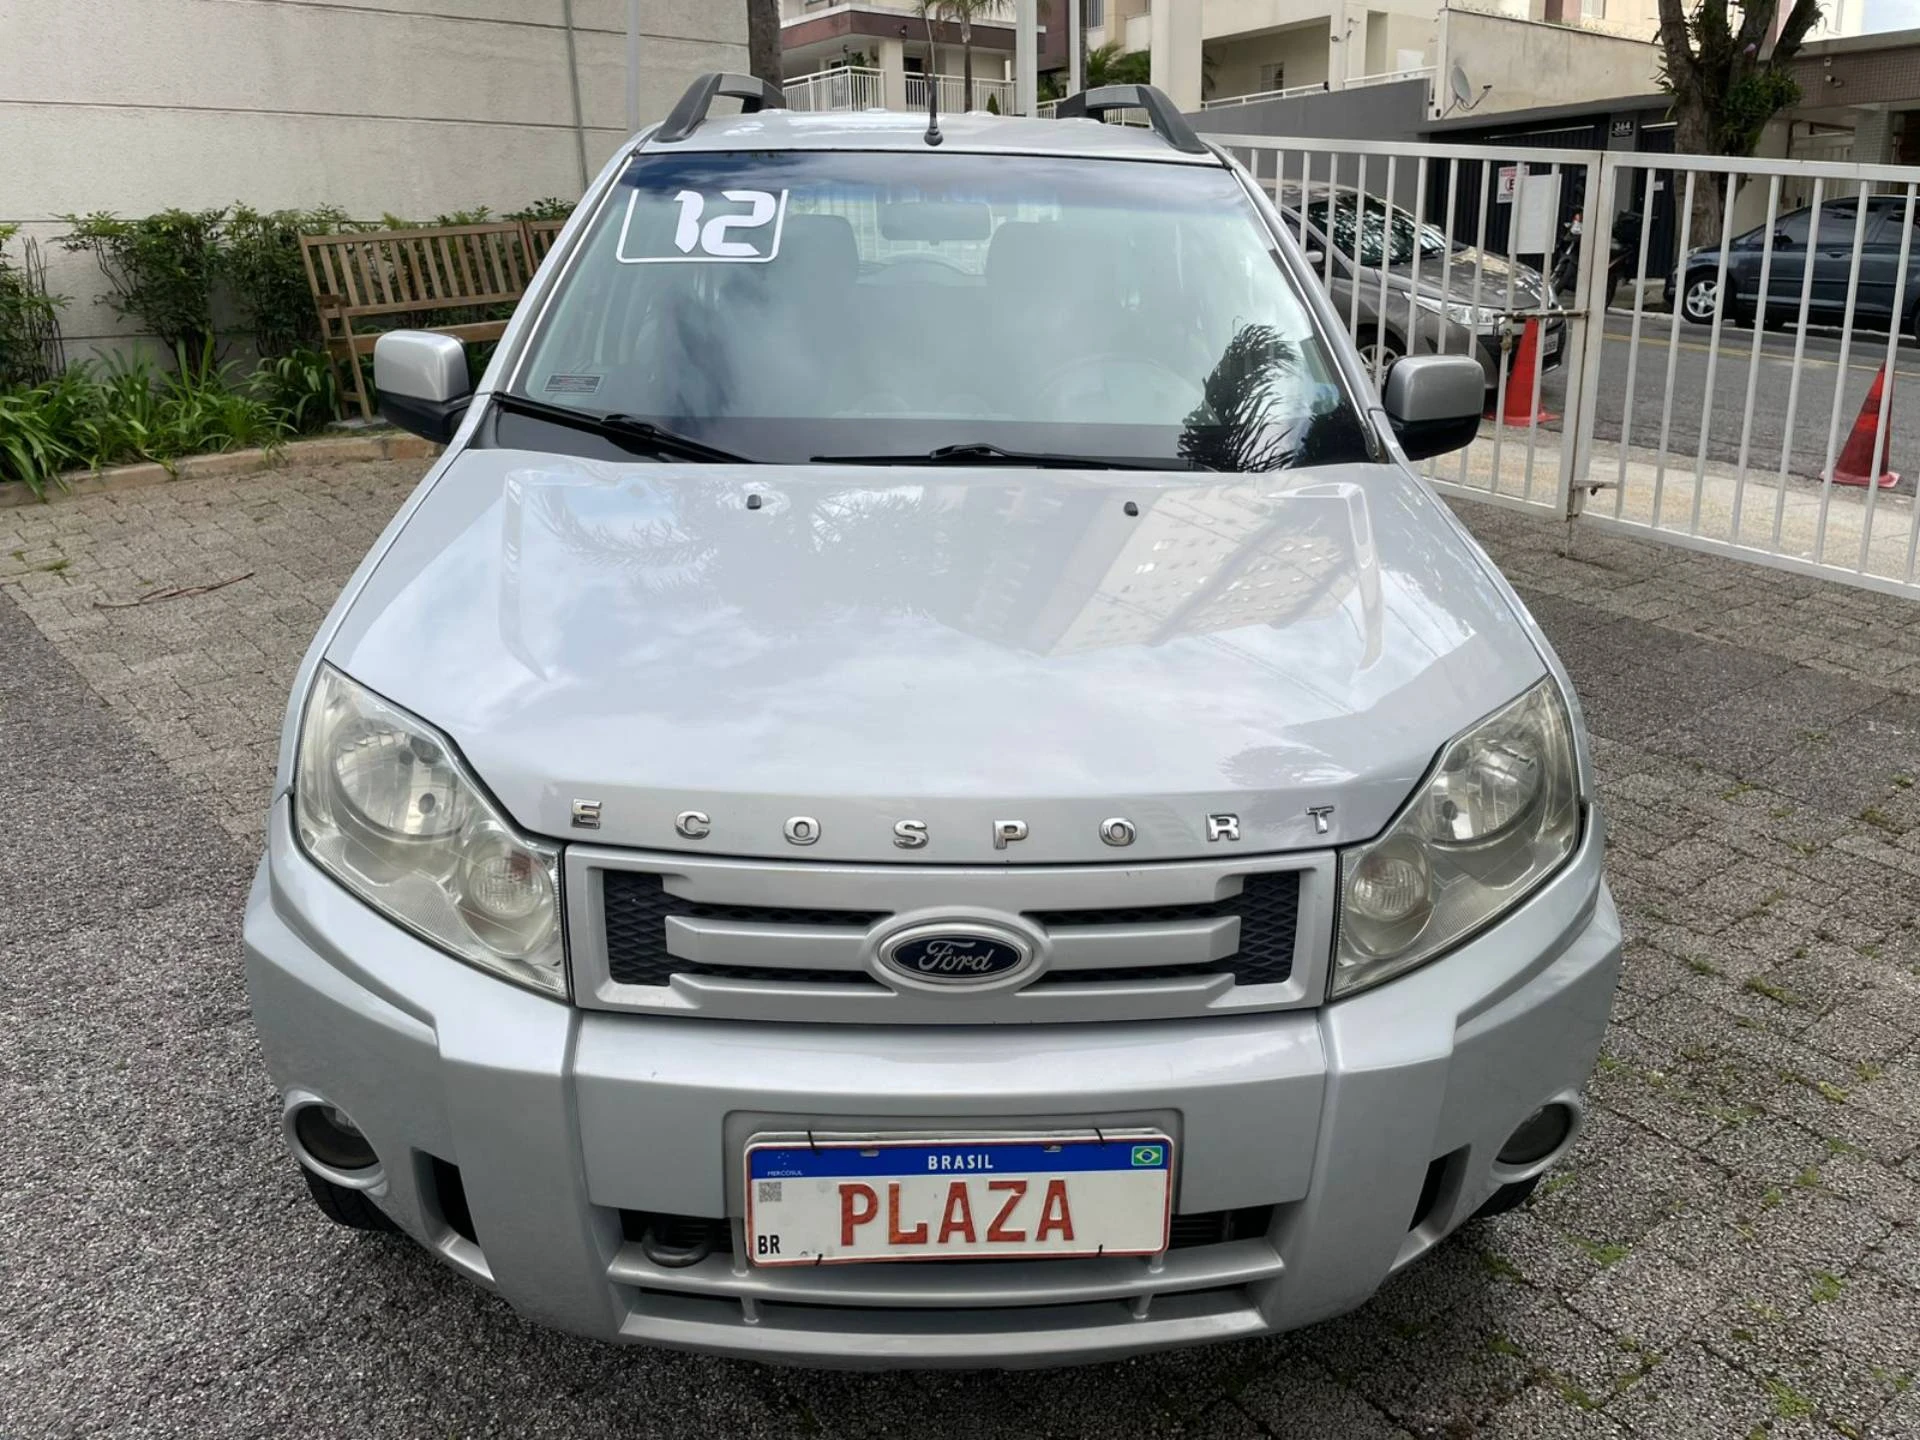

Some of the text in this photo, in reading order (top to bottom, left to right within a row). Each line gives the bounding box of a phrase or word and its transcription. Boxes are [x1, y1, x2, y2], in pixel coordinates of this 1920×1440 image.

[673, 189, 777, 257] 12
[570, 798, 1335, 850] ECOSPORT
[918, 940, 995, 971] Ford
[767, 1169, 803, 1177] MERCOSUL
[927, 1154, 994, 1170] BRASIL
[838, 1179, 1075, 1246] PLAZA
[758, 1235, 780, 1255] BR
